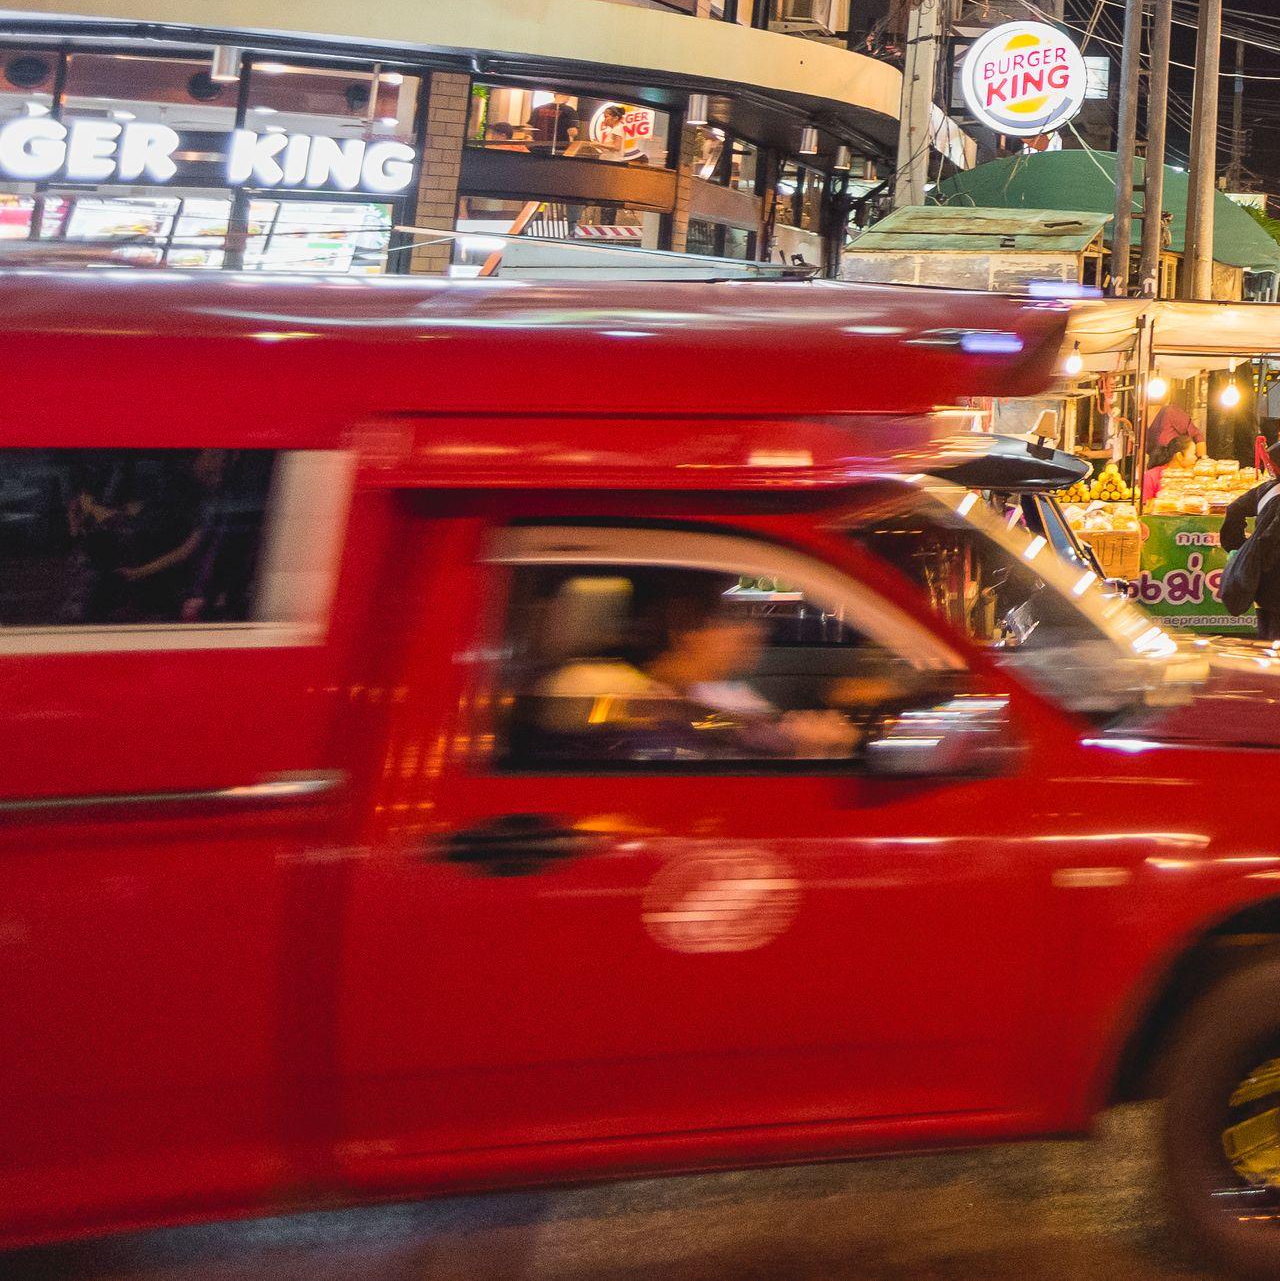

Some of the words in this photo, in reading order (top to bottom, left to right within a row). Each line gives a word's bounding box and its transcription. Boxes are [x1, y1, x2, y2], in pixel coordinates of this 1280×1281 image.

[984, 48, 1066, 80] BURGER
[987, 65, 1069, 106] KING
[623, 122, 649, 138] NG
[624, 111, 648, 123] GER
[226, 128, 416, 193] KING
